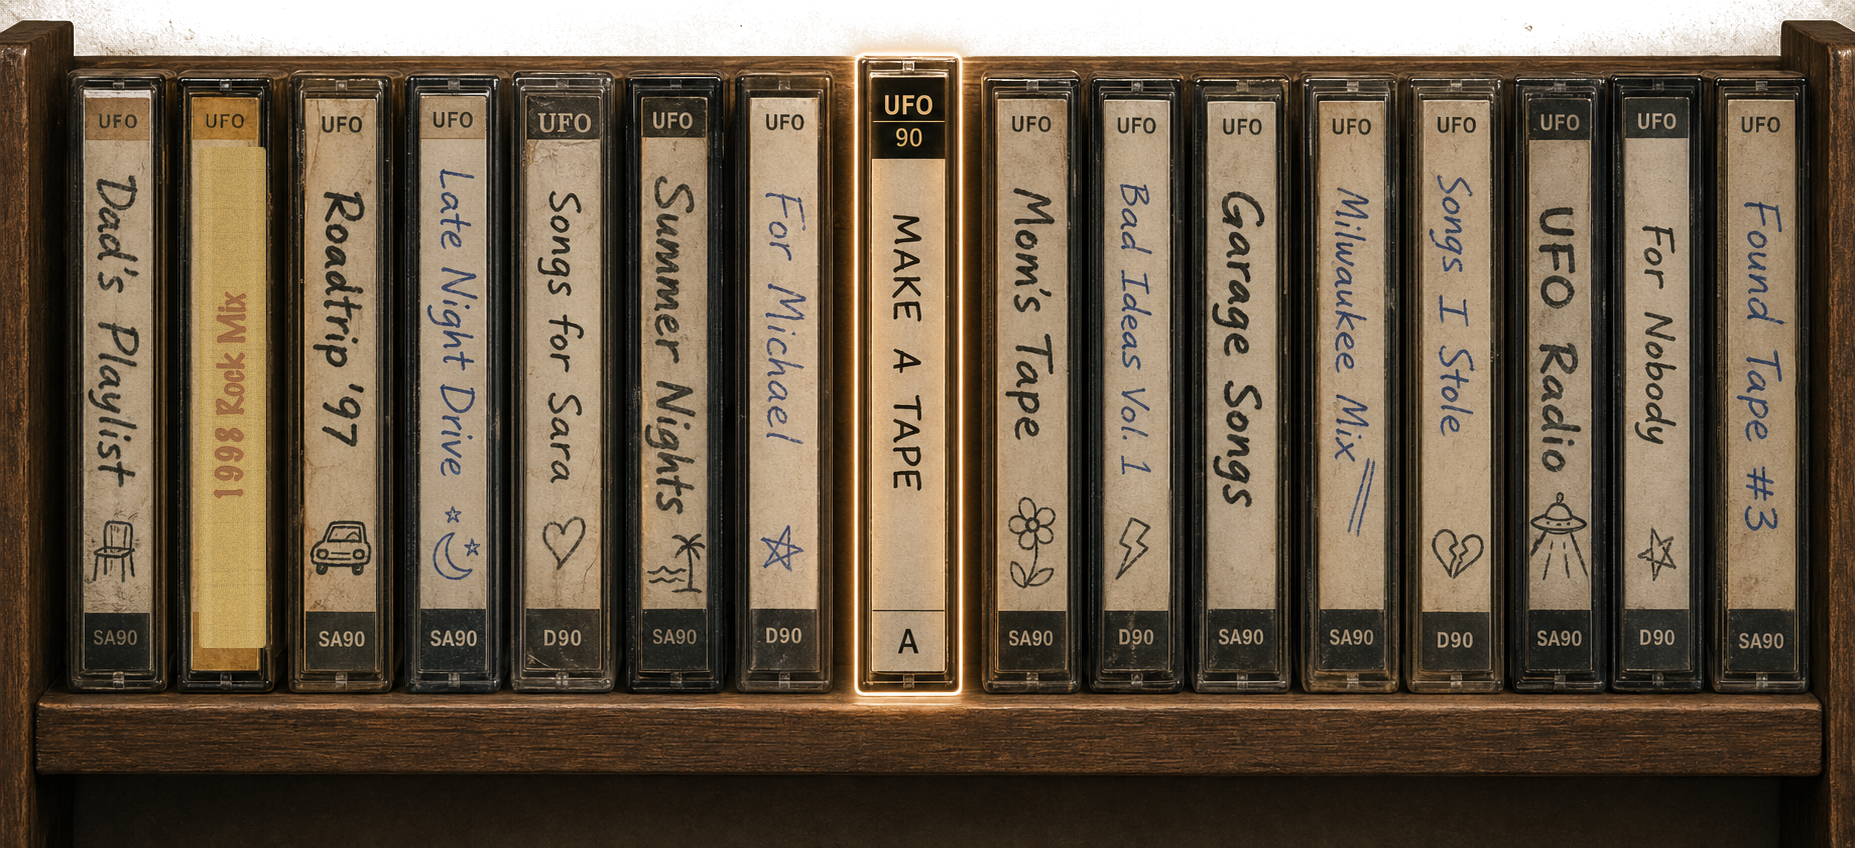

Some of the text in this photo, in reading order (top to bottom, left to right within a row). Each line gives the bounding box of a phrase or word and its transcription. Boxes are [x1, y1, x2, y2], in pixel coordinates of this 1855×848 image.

[883, 94, 934, 116] UFO
[99, 113, 138, 129] UFO
[205, 113, 245, 129] UFO
[321, 115, 363, 134] UFO
[433, 111, 474, 129] UFO
[537, 112, 592, 134] UFO
[652, 111, 694, 130] UFO
[765, 113, 805, 131] UFO
[1011, 115, 1052, 133] UFO
[1117, 117, 1157, 135] UFO
[1222, 118, 1263, 135] UFO
[1332, 118, 1372, 135] UFO
[1437, 116, 1477, 134] UFO
[1540, 113, 1580, 131] UFO
[1637, 112, 1677, 130] UFO
[1741, 116, 1781, 134] UFO
[895, 127, 923, 148] 90
[1005, 187, 1055, 440] Mom's Tape
[1429, 174, 1475, 436] Songs I Stole
[312, 191, 365, 447] Roadtrip '97
[427, 168, 478, 477] Late Night Drive
[765, 192, 807, 445] For Michael
[1333, 187, 1370, 463] Milwaukee Mix
[88, 175, 139, 487] Dad's Playlist
[537, 190, 584, 483] Songs for Sara
[1119, 183, 1152, 475] Bad Ideas Vol. 1
[1634, 225, 1677, 445] For Nobody
[644, 175, 696, 515] Summer Nights
[1538, 206, 1582, 473] UFO Radio
[892, 213, 923, 491] MAKE A TAPE
[1211, 191, 1265, 508] Garage Songs
[1736, 200, 1786, 531] Found Tape #3
[213, 291, 247, 499] 1998 Rock Mix
[93, 629, 138, 647] SA90
[318, 630, 366, 648] SA90
[429, 629, 478, 648] SA90
[543, 628, 582, 648] D90
[652, 628, 697, 646] SA90
[765, 626, 803, 645] D90
[897, 628, 919, 655] A
[1008, 629, 1054, 647] SA90
[1118, 628, 1155, 646] D90
[1218, 628, 1264, 646] SA90
[1329, 628, 1374, 646] SA90
[1436, 631, 1474, 649] D90
[1536, 629, 1583, 647] SA90
[1639, 629, 1676, 647] D90
[1738, 632, 1785, 650] SA90
